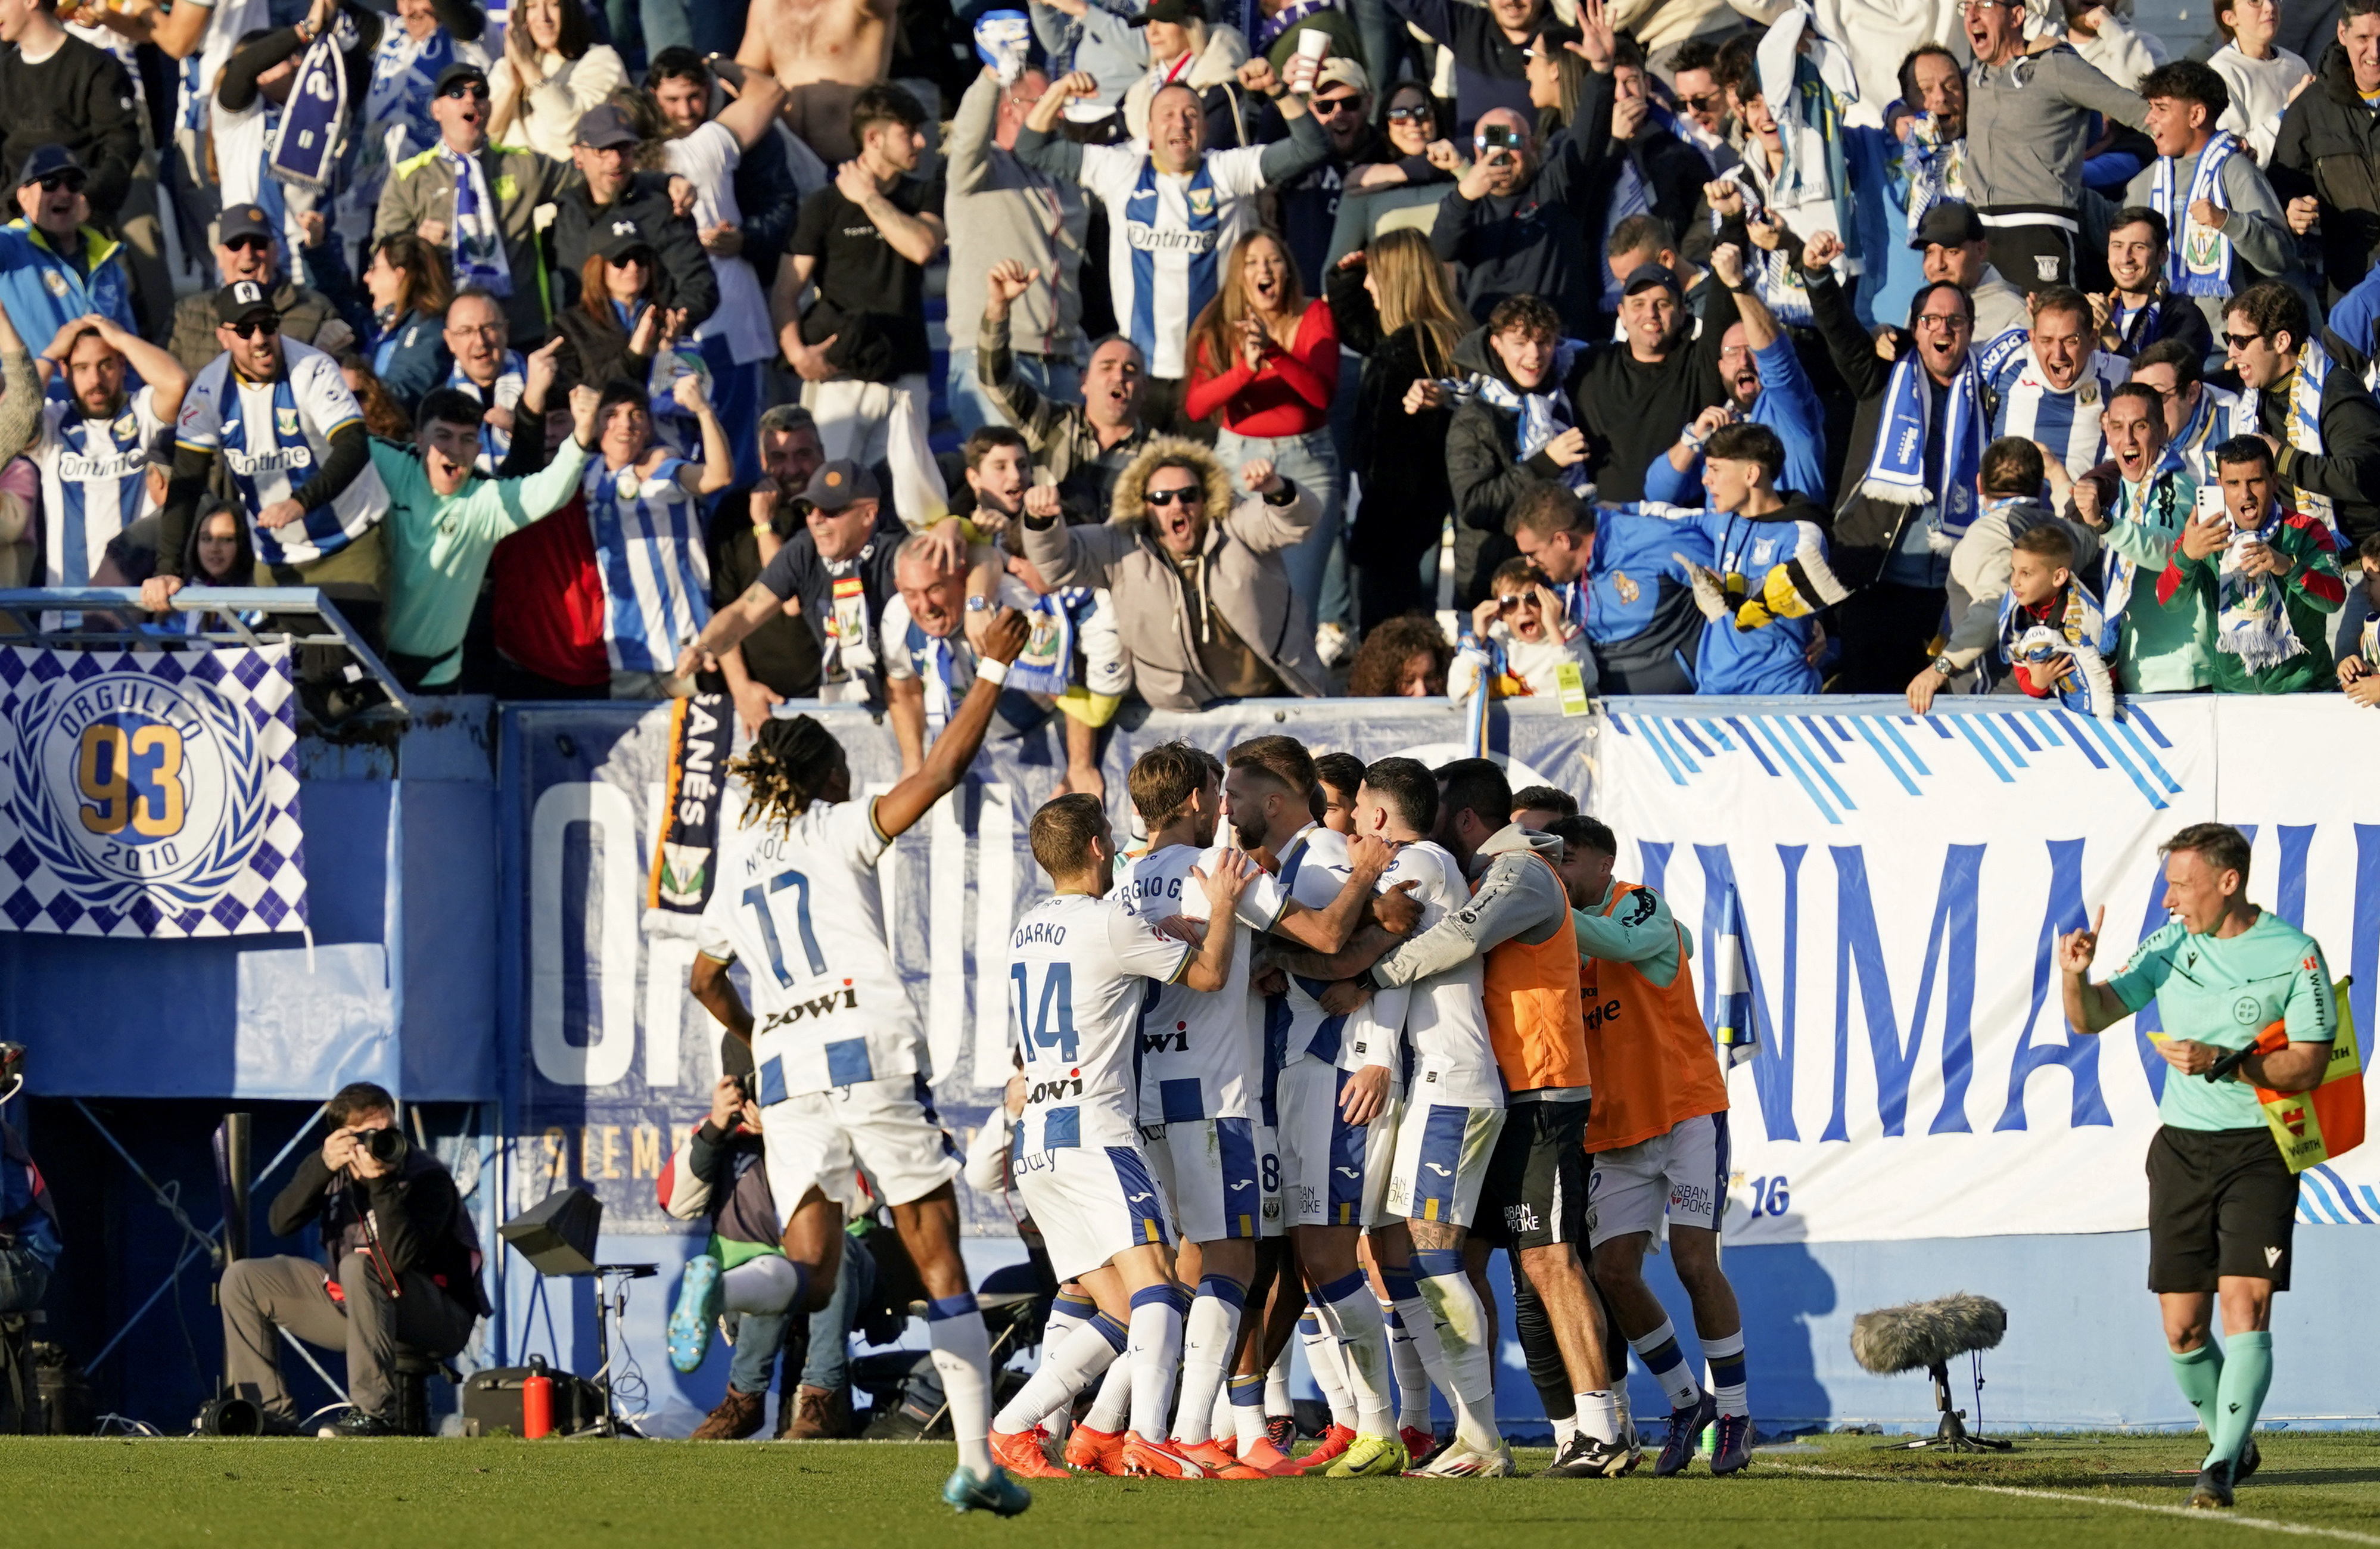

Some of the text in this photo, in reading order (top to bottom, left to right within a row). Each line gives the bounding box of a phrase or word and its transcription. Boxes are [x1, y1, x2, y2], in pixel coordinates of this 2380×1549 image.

[1131, 223, 1215, 250] Ontim
[226, 447, 307, 474] Ontime
[60, 682, 203, 741] ORGULLO
[79, 724, 185, 838] 93
[101, 842, 179, 872] 2010
[1167, 878, 1183, 902] G.
[742, 869, 827, 990] 17
[1016, 922, 1066, 948] DARKO
[761, 978, 858, 1035] zowi
[1011, 962, 1080, 1060] 14
[1261, 1153, 1280, 1193] 8
[1504, 1203, 1531, 1220] RBAN
[1681, 1197, 1713, 1216] POKE
[1750, 1175, 1790, 1219] 16
[1511, 1215, 1540, 1233] POKE
